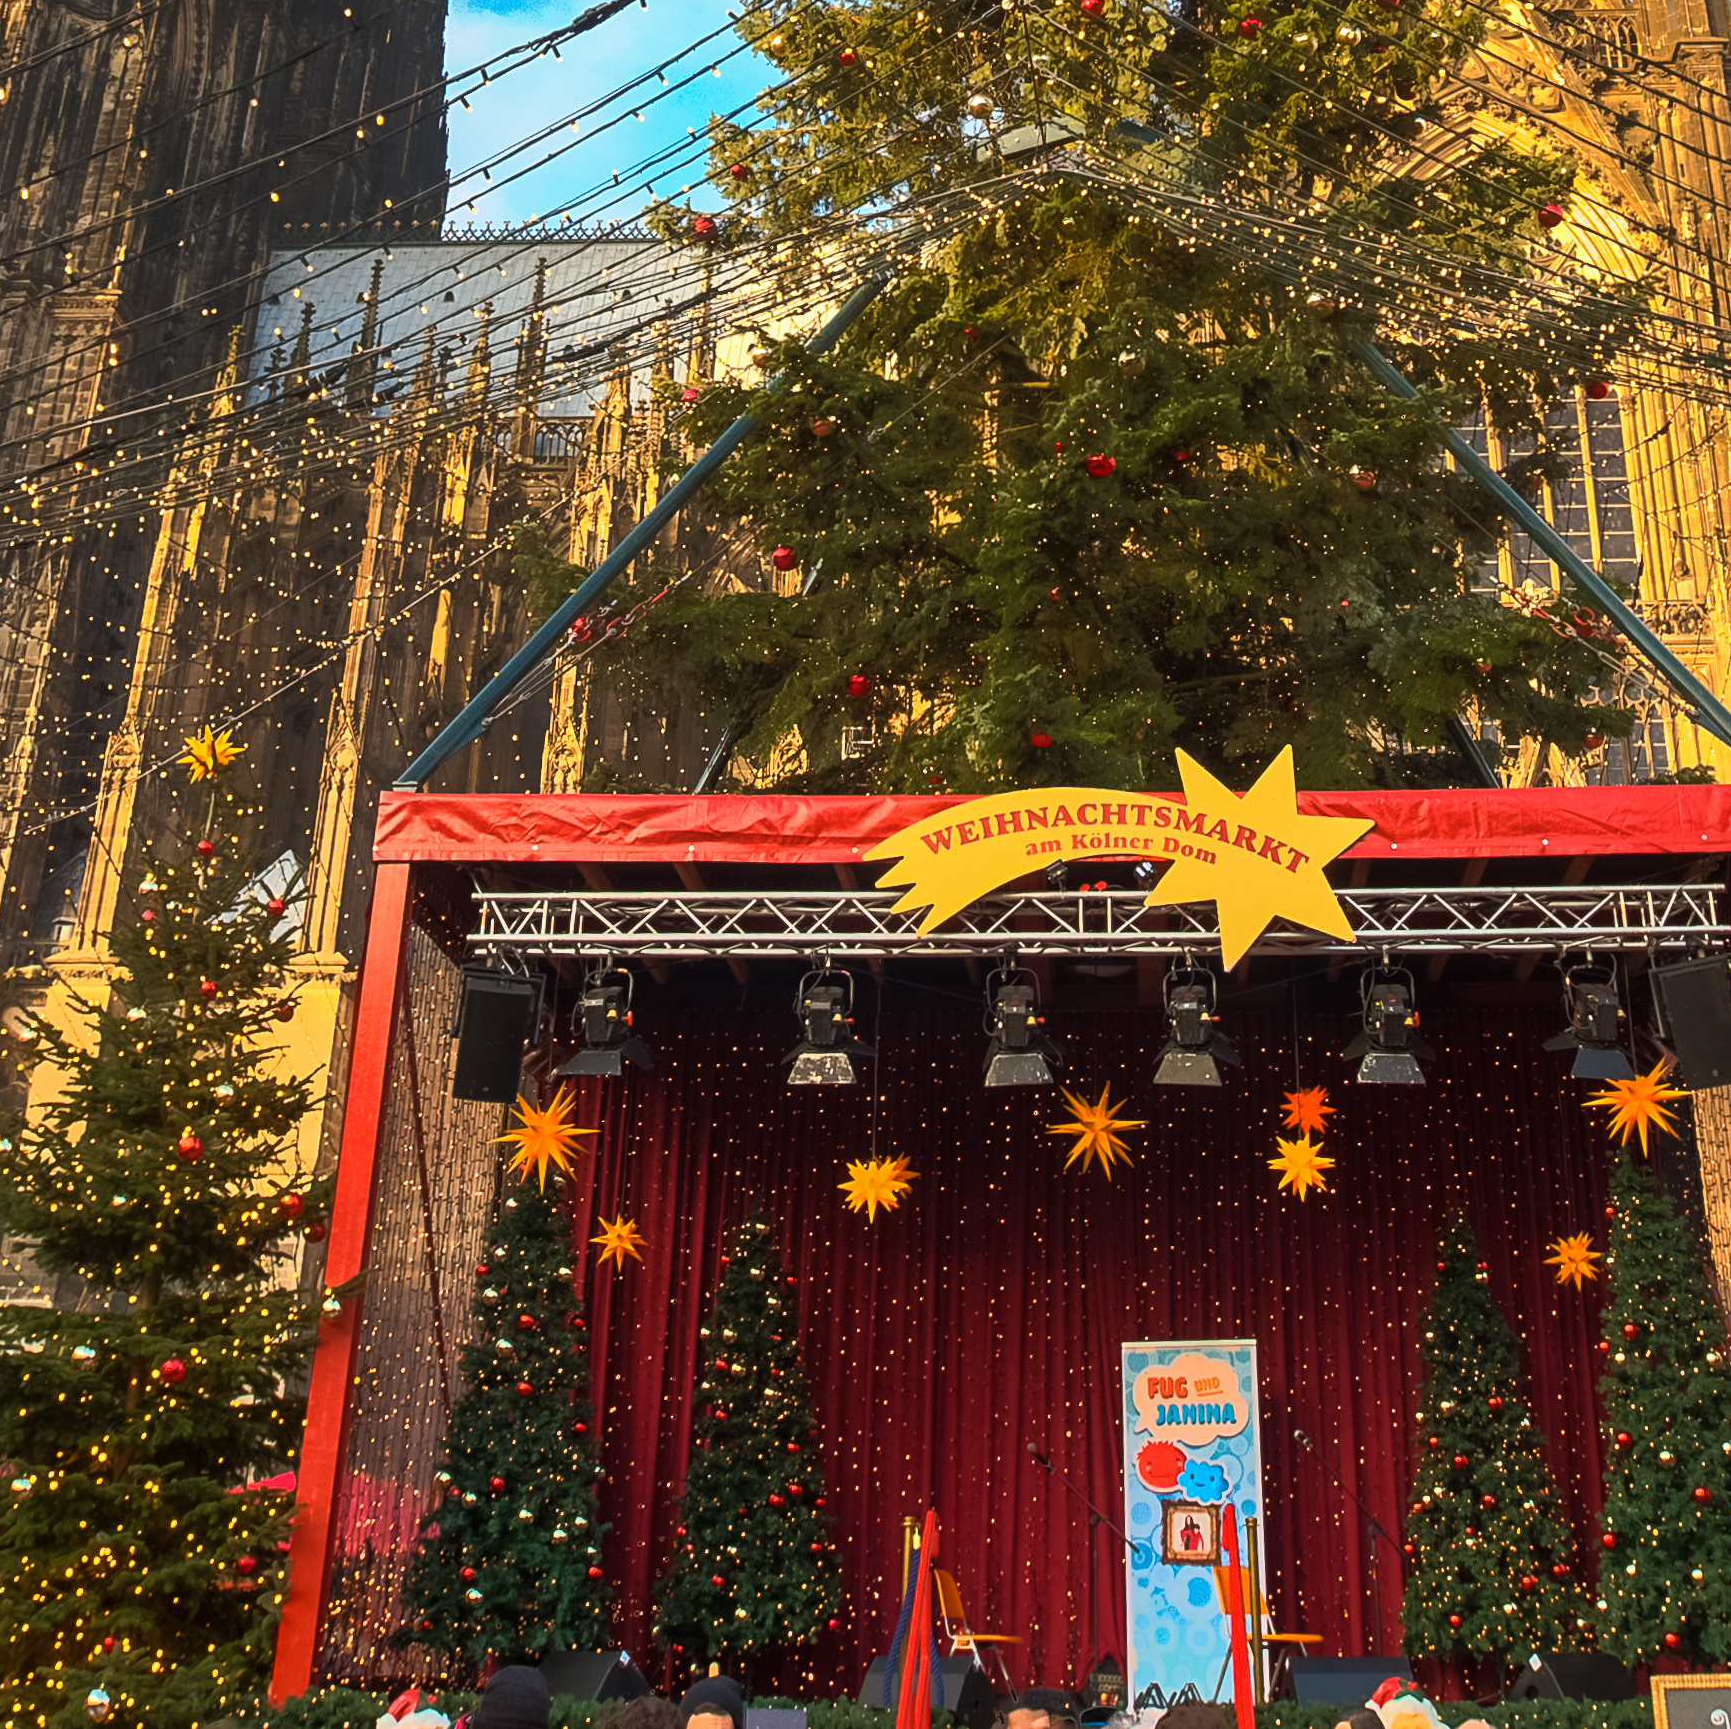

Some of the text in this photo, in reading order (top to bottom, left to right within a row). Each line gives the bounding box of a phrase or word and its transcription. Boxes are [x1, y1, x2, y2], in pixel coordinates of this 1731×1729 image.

[920, 803, 1310, 873] WEIHNACHTSMARKT
[1026, 832, 1217, 864] am Kölner Dom
[1147, 1376, 1220, 1399] FUG UND
[1155, 1403, 1237, 1426] JANINA
